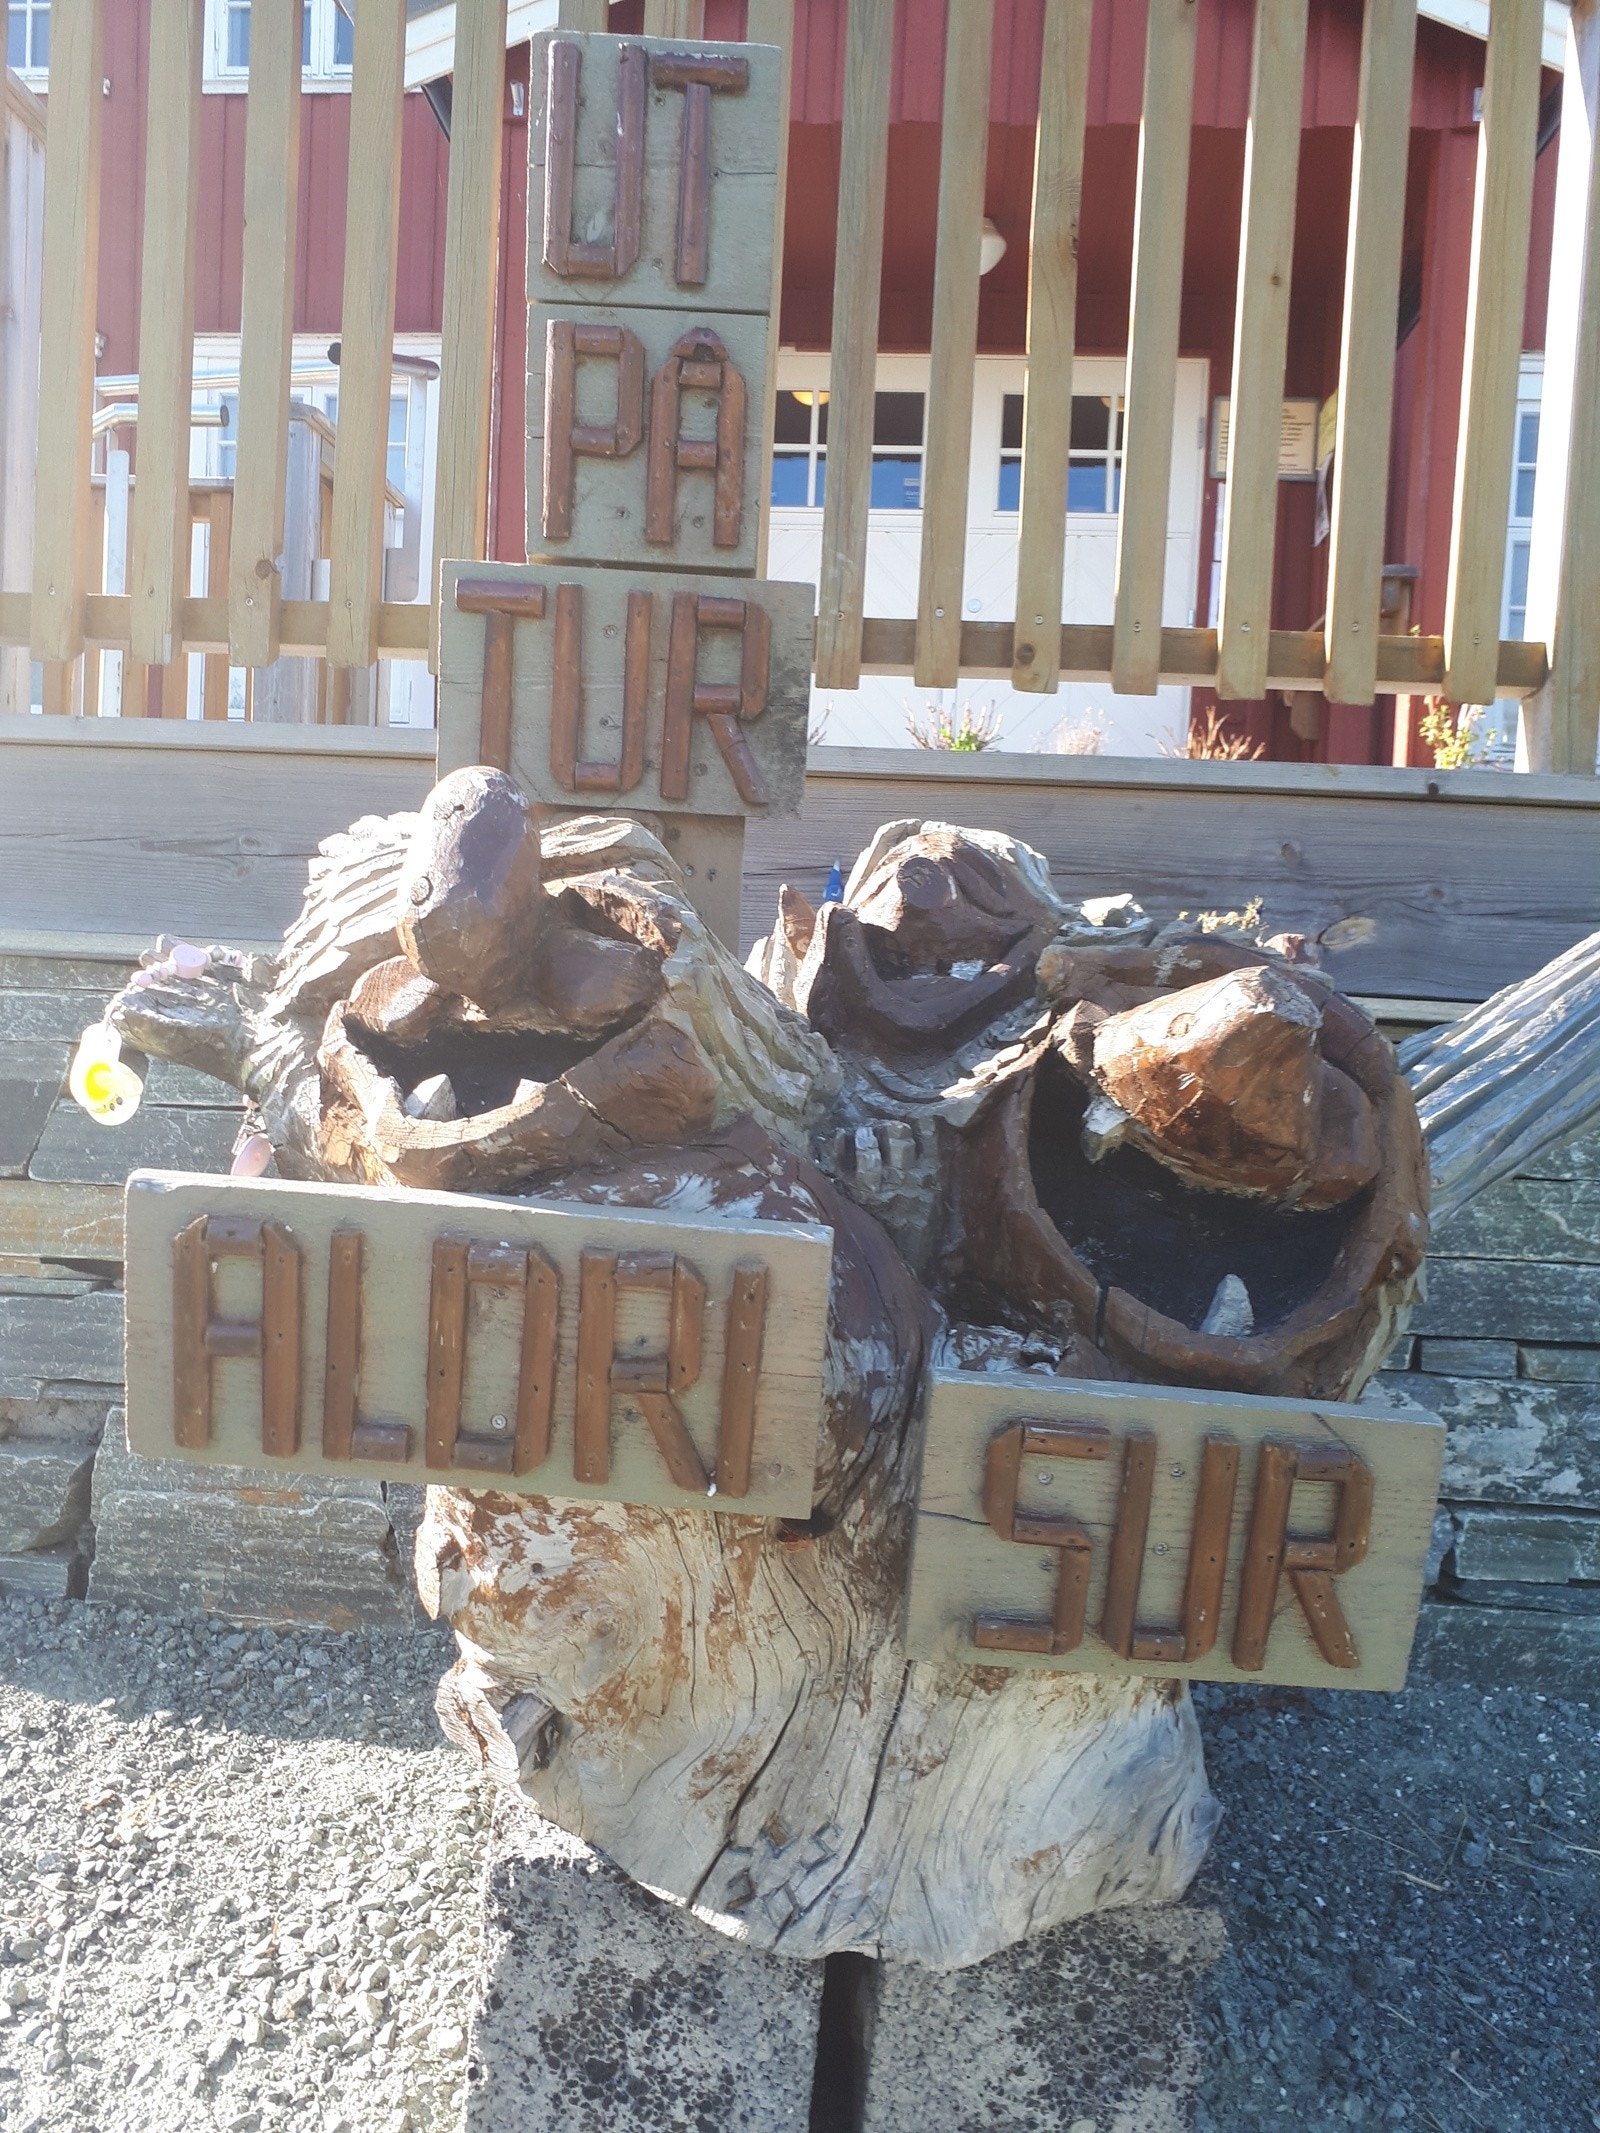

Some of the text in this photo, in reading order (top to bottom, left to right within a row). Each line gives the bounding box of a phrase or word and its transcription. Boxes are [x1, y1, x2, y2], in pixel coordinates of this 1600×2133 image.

[544, 40, 748, 285] UT
[455, 578, 772, 806] TUR
[172, 1213, 769, 1499] ALDRI
[974, 1417, 1375, 1672] SUR
